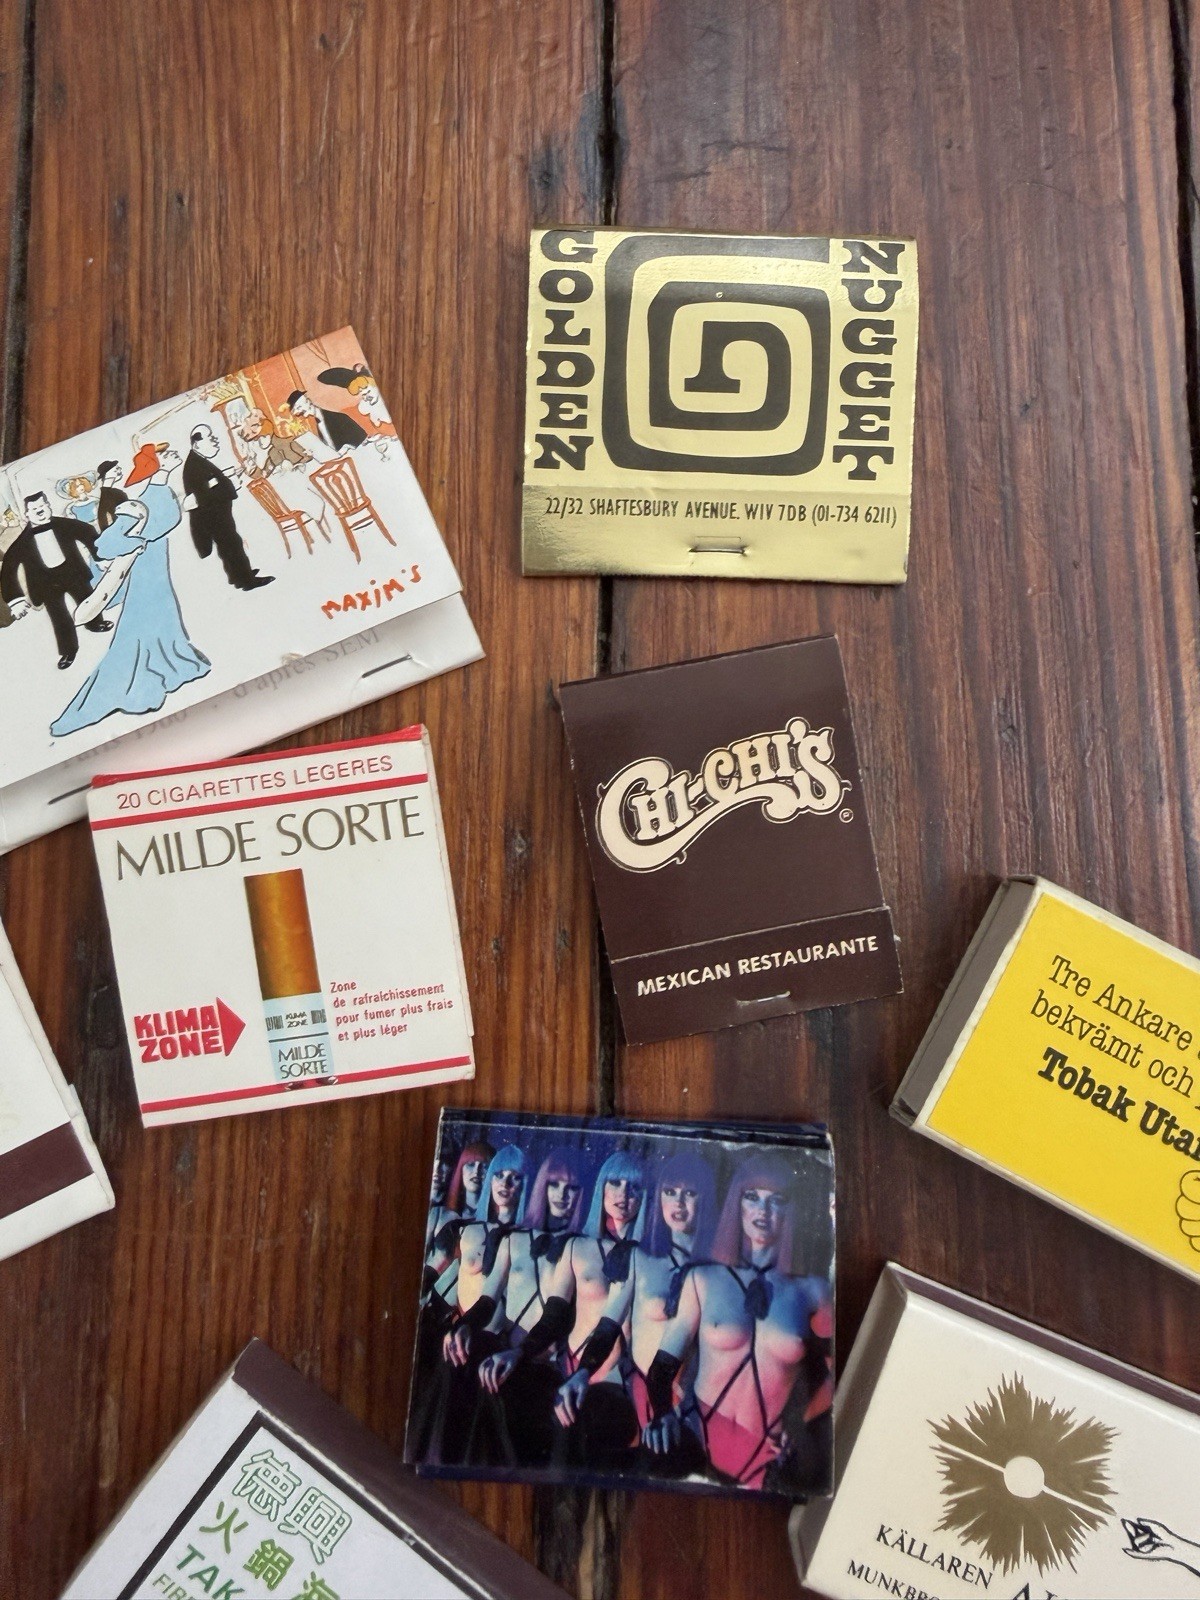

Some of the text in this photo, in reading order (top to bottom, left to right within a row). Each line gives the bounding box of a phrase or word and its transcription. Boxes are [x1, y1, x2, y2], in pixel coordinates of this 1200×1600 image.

[534, 230, 598, 471] GOLDEN
[832, 241, 905, 480] NUGGET
[545, 497, 584, 517] 22/32
[590, 498, 678, 518] SHAFTESBURY
[778, 504, 807, 522] 7DB
[325, 628, 380, 662] SEM
[117, 755, 394, 810] 20 CIGARETTES LEGERES
[116, 795, 424, 881] MILDE SORTE
[636, 935, 879, 997] MEXICAN RESTAURANTE
[330, 981, 357, 994] Zone
[333, 997, 346, 1009] de
[1048, 954, 1193, 1051] Tre Ankare
[133, 1004, 219, 1040] KLIMA
[336, 998, 454, 1026] pour fumer plus frais
[138, 1030, 224, 1064] ZONE
[278, 1042, 327, 1062] MILDE
[338, 1031, 349, 1041] et
[353, 1028, 376, 1041] plus
[1029, 989, 1195, 1098] bekvämt och
[280, 1059, 328, 1079] SORTE
[1037, 1046, 1136, 1122] Tobak
[176, 1543, 245, 1600] TAK
[876, 1524, 993, 1589] KÄLLAREN
[152, 1573, 196, 1600] FIR
